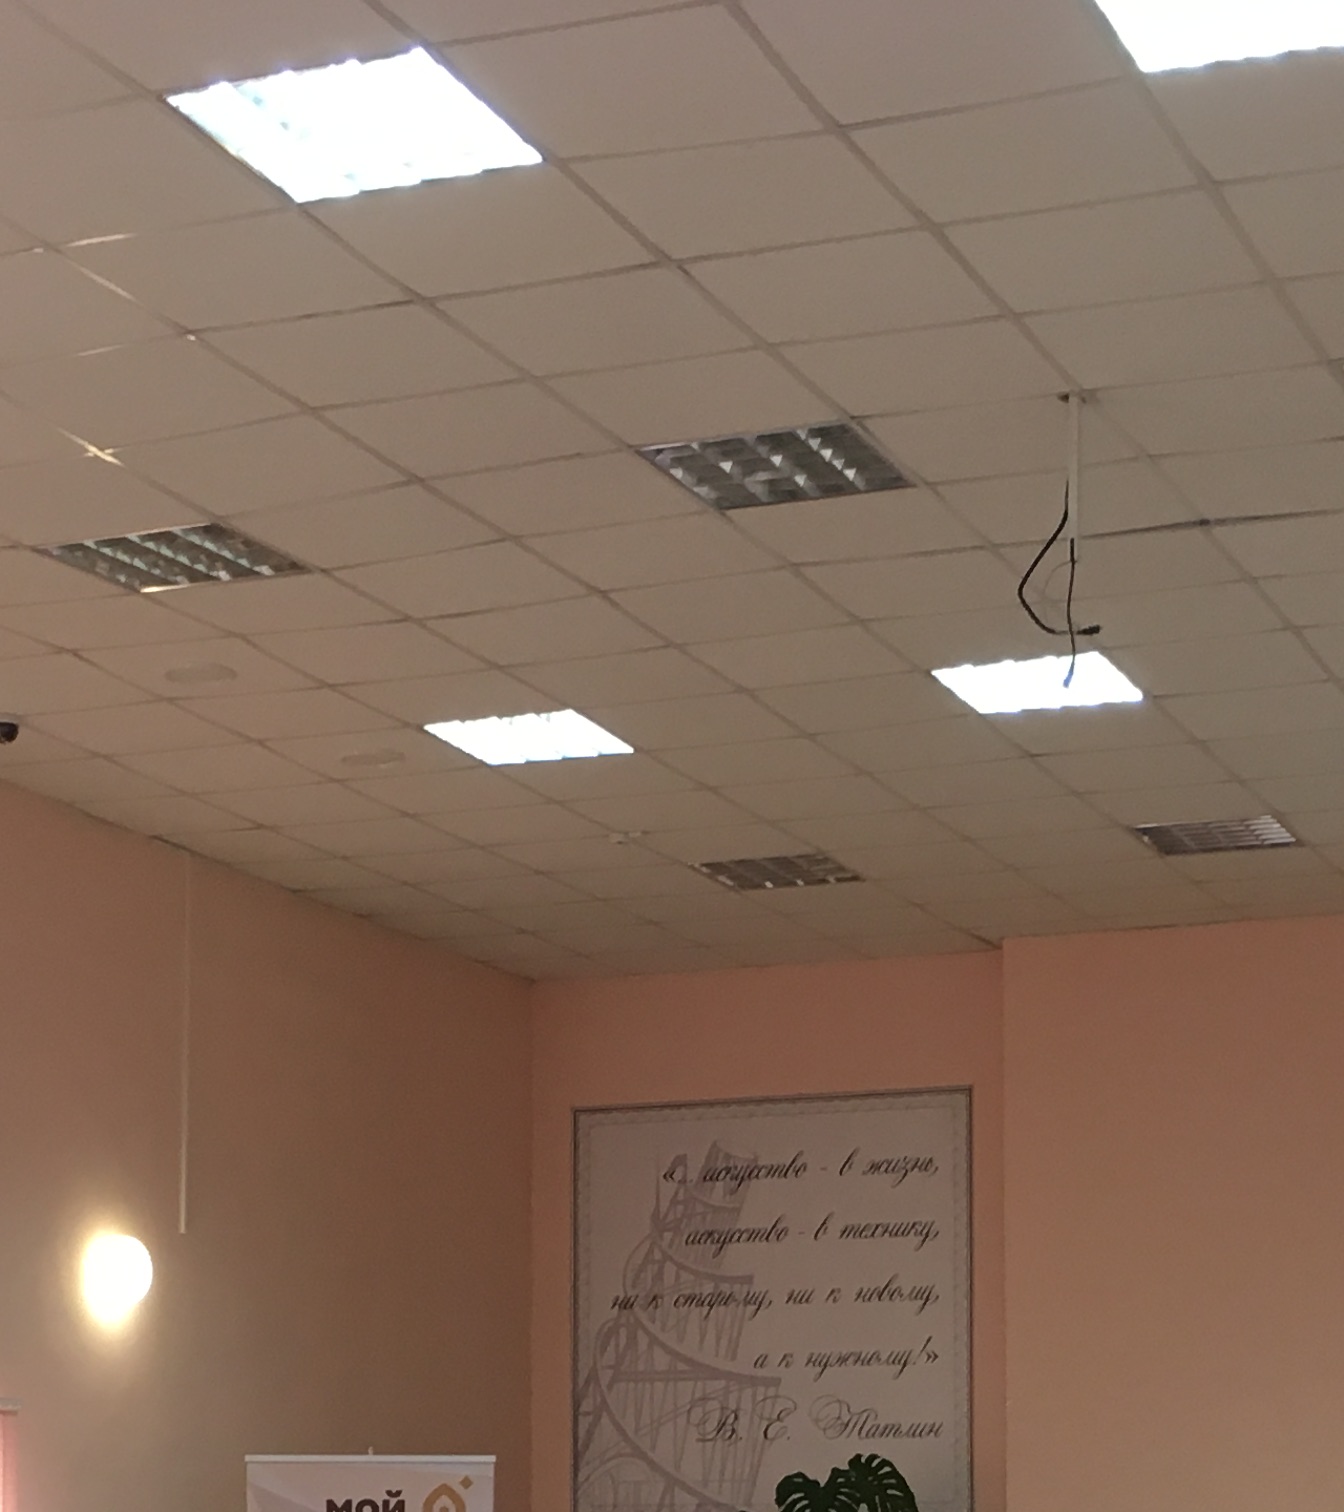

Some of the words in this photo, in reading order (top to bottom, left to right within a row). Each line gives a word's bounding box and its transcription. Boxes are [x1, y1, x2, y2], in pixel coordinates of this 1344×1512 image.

[703, 1151, 808, 1196] искусство
[839, 1147, 860, 1177] в
[862, 1155, 939, 1189] жизнь,
[684, 1213, 790, 1260] искусство
[813, 1211, 834, 1242] в
[838, 1219, 940, 1252] технику,
[610, 1293, 640, 1311] ни
[673, 1287, 772, 1321] старому,
[785, 1287, 815, 1305] ни
[824, 1287, 842, 1304] к
[853, 1273, 940, 1317] новому,
[753, 1352, 768, 1370] а
[776, 1351, 794, 1369] к
